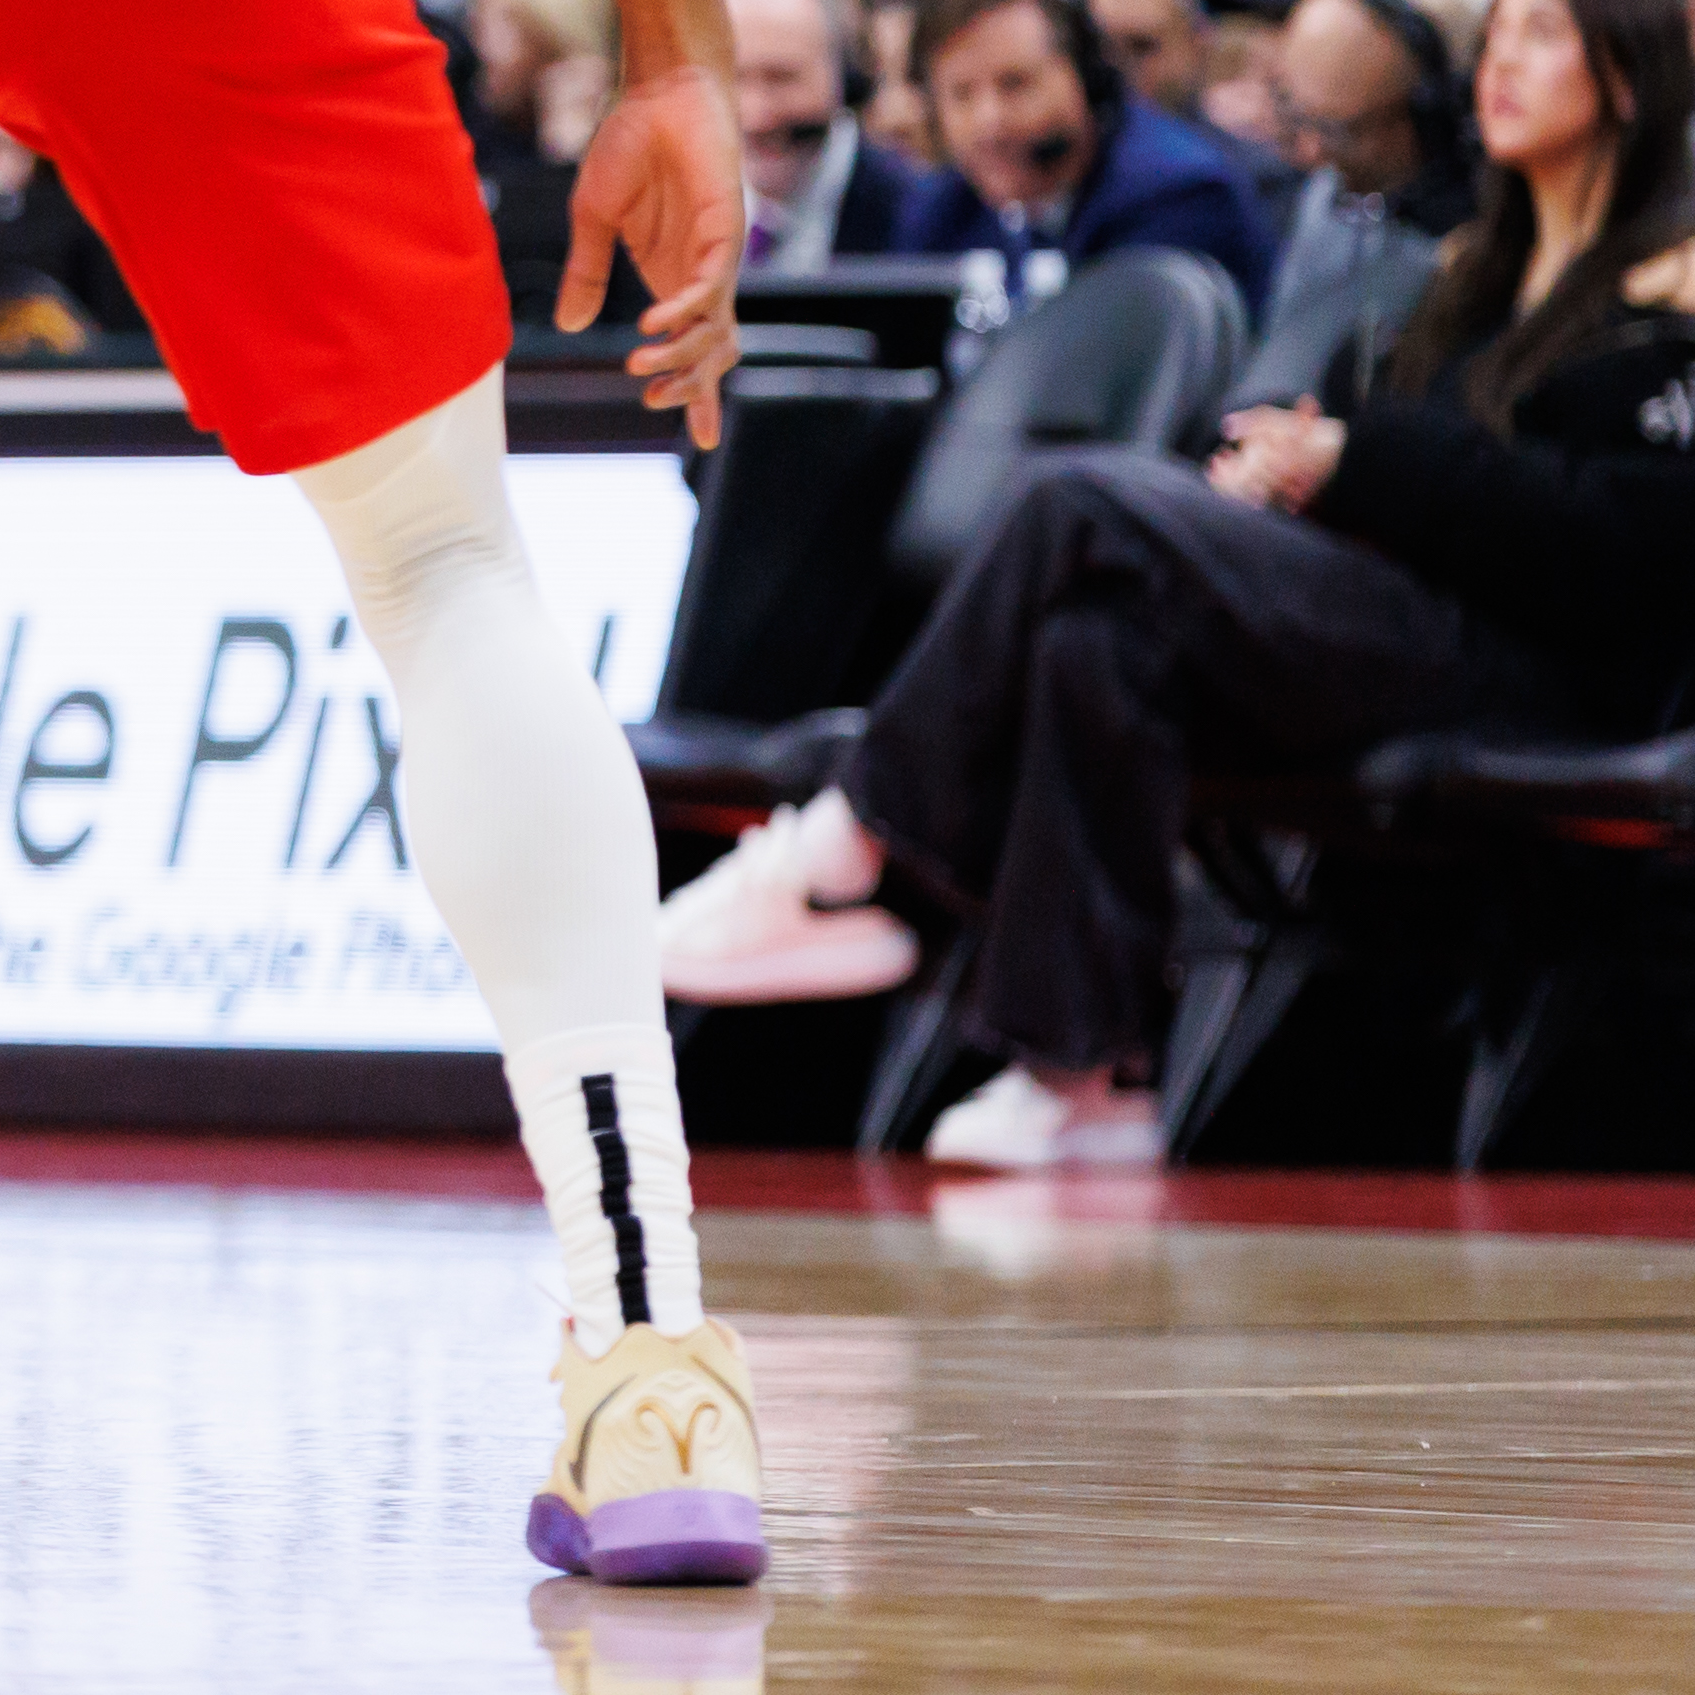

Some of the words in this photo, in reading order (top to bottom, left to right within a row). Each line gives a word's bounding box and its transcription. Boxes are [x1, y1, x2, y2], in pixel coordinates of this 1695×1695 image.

[167, 613, 613, 870] Pix
[72, 901, 310, 1019] Google
[326, 908, 474, 997] Pho
